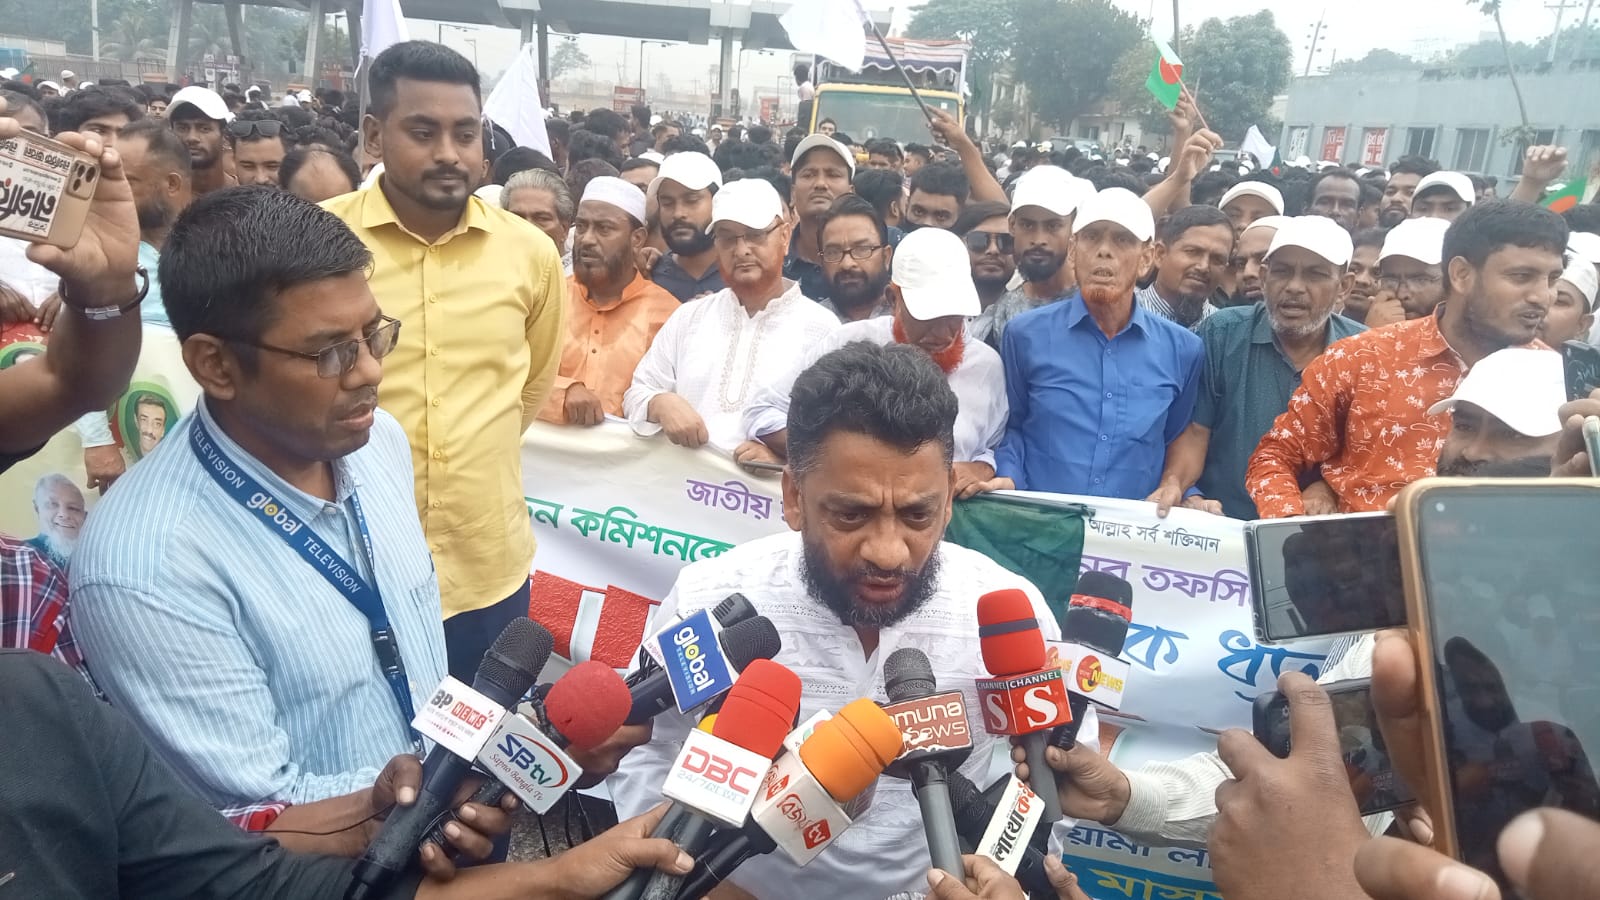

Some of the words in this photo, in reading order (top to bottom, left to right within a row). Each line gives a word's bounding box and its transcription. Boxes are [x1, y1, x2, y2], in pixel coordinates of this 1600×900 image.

[192, 425, 246, 489] TELEVISION
[246, 492, 303, 536] global
[304, 536, 360, 593] TELEVISION
[687, 479, 772, 520] জাতীয়
[1089, 519, 1132, 539] আল্লাহ
[1136, 523, 1160, 543] সর্ব
[1163, 527, 1221, 554] শক্তিমান
[673, 626, 715, 693] global
[676, 647, 696, 695] TELEVISION
[1009, 671, 1060, 689] CHANNEL
[977, 681, 1007, 690] CHANNEL
[1091, 669, 1123, 692] NEWS
[451, 701, 488, 731] NEWS
[986, 693, 1008, 731] S
[1024, 685, 1058, 728] S
[489, 753, 511, 776] Sapno
[511, 769, 534, 796] Bangla
[682, 746, 758, 795] DBC
